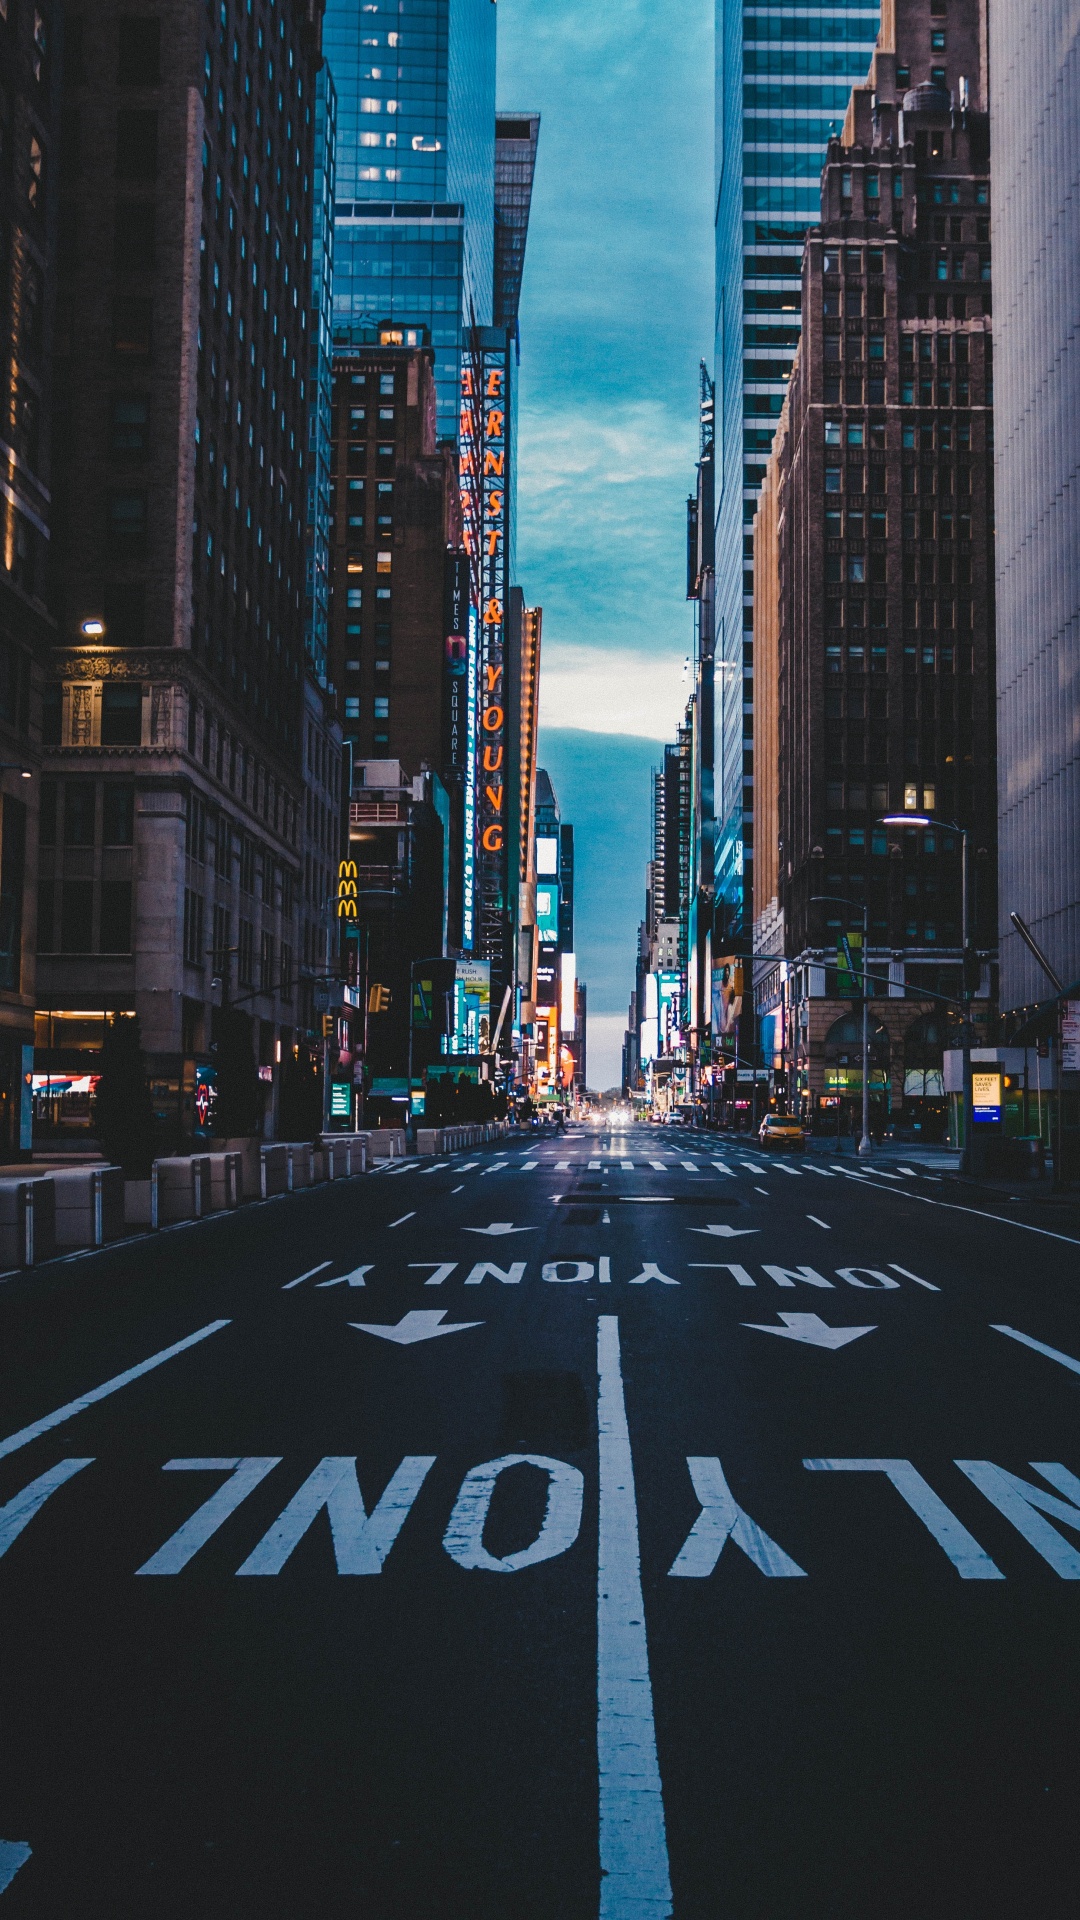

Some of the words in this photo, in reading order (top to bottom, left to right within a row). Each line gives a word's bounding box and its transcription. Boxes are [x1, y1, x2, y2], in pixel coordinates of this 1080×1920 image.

[483, 371, 504, 556] ERNST
[452, 561, 460, 630] TIMES
[483, 598, 503, 624] &
[451, 681, 459, 765] SQUARE
[482, 665, 504, 851] YOUNG
[314, 1261, 595, 1287] ONLY
[628, 1262, 901, 1290] ONLY
